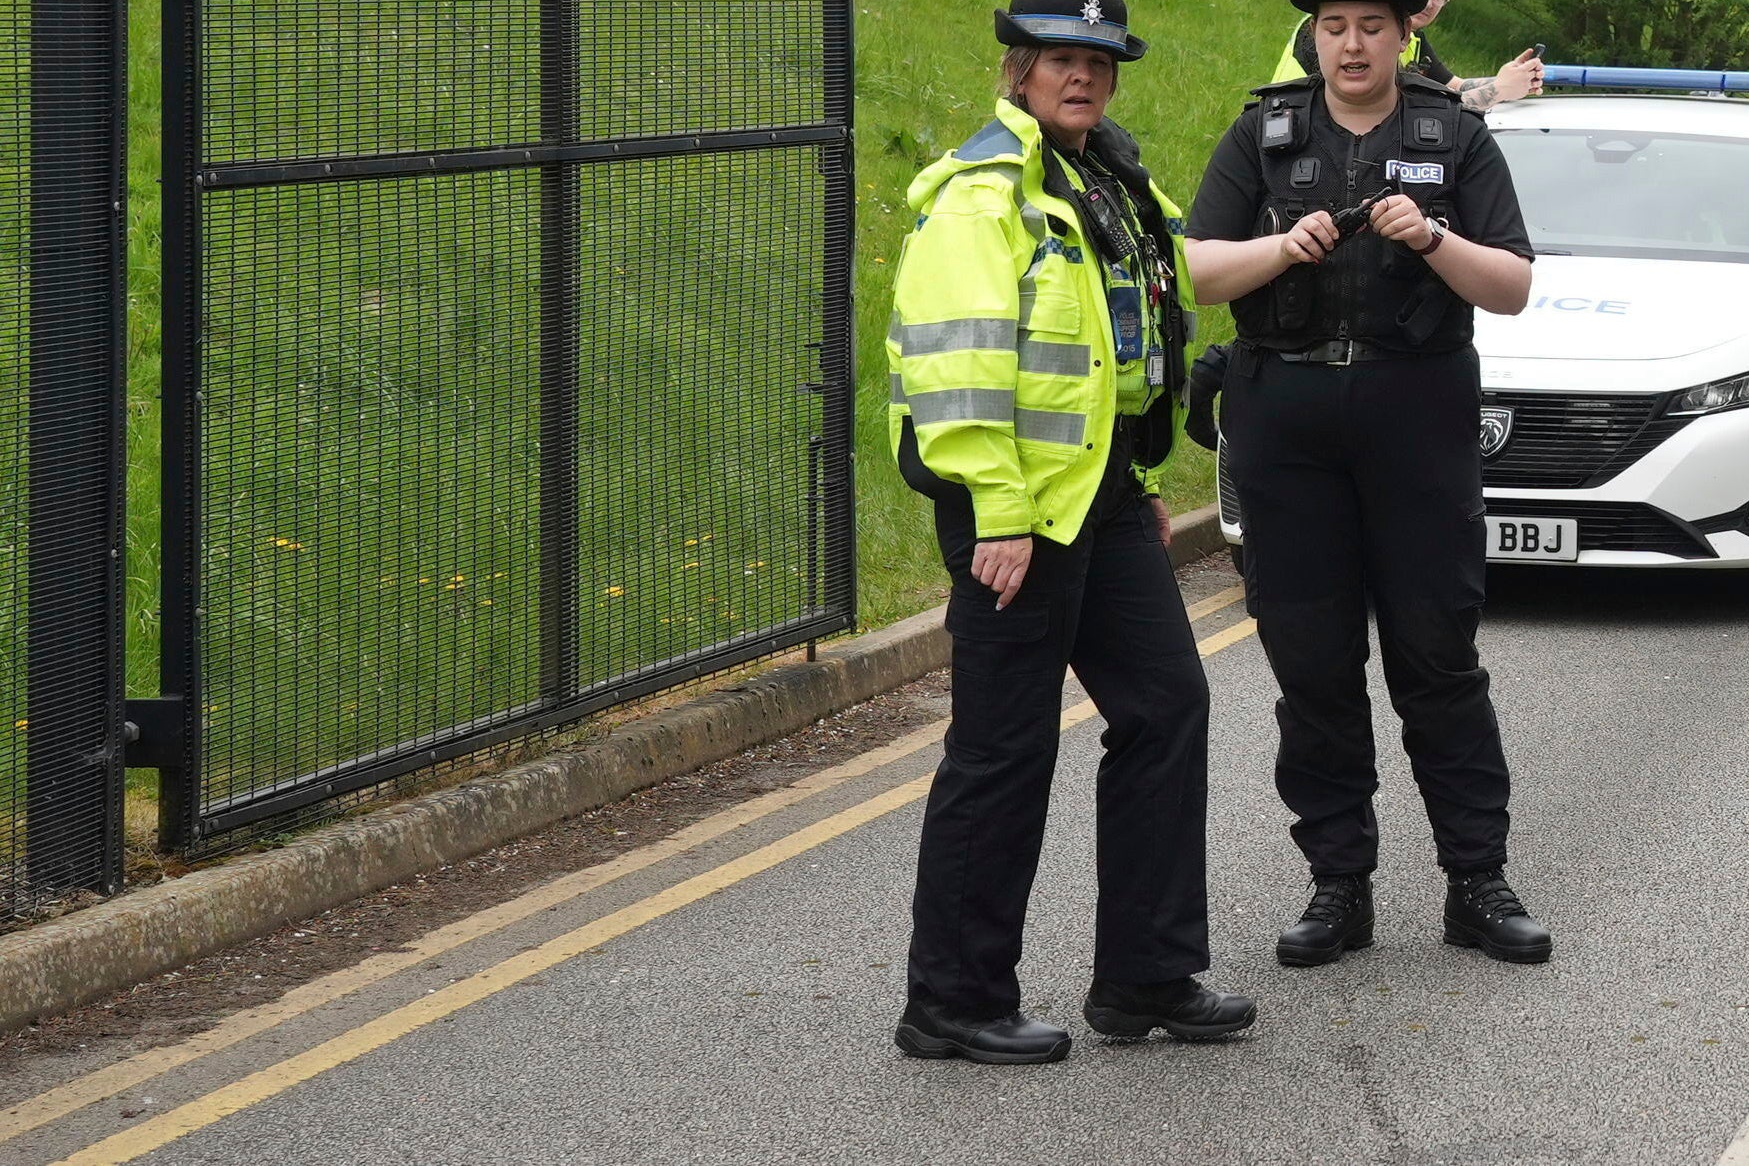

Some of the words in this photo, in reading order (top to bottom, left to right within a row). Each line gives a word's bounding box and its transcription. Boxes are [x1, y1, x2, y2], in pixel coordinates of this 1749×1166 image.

[1391, 163, 1439, 179] POLICE
[1534, 296, 1632, 315] ICE
[1480, 411, 1508, 419] UGEOT
[1498, 522, 1562, 553] BBJ
